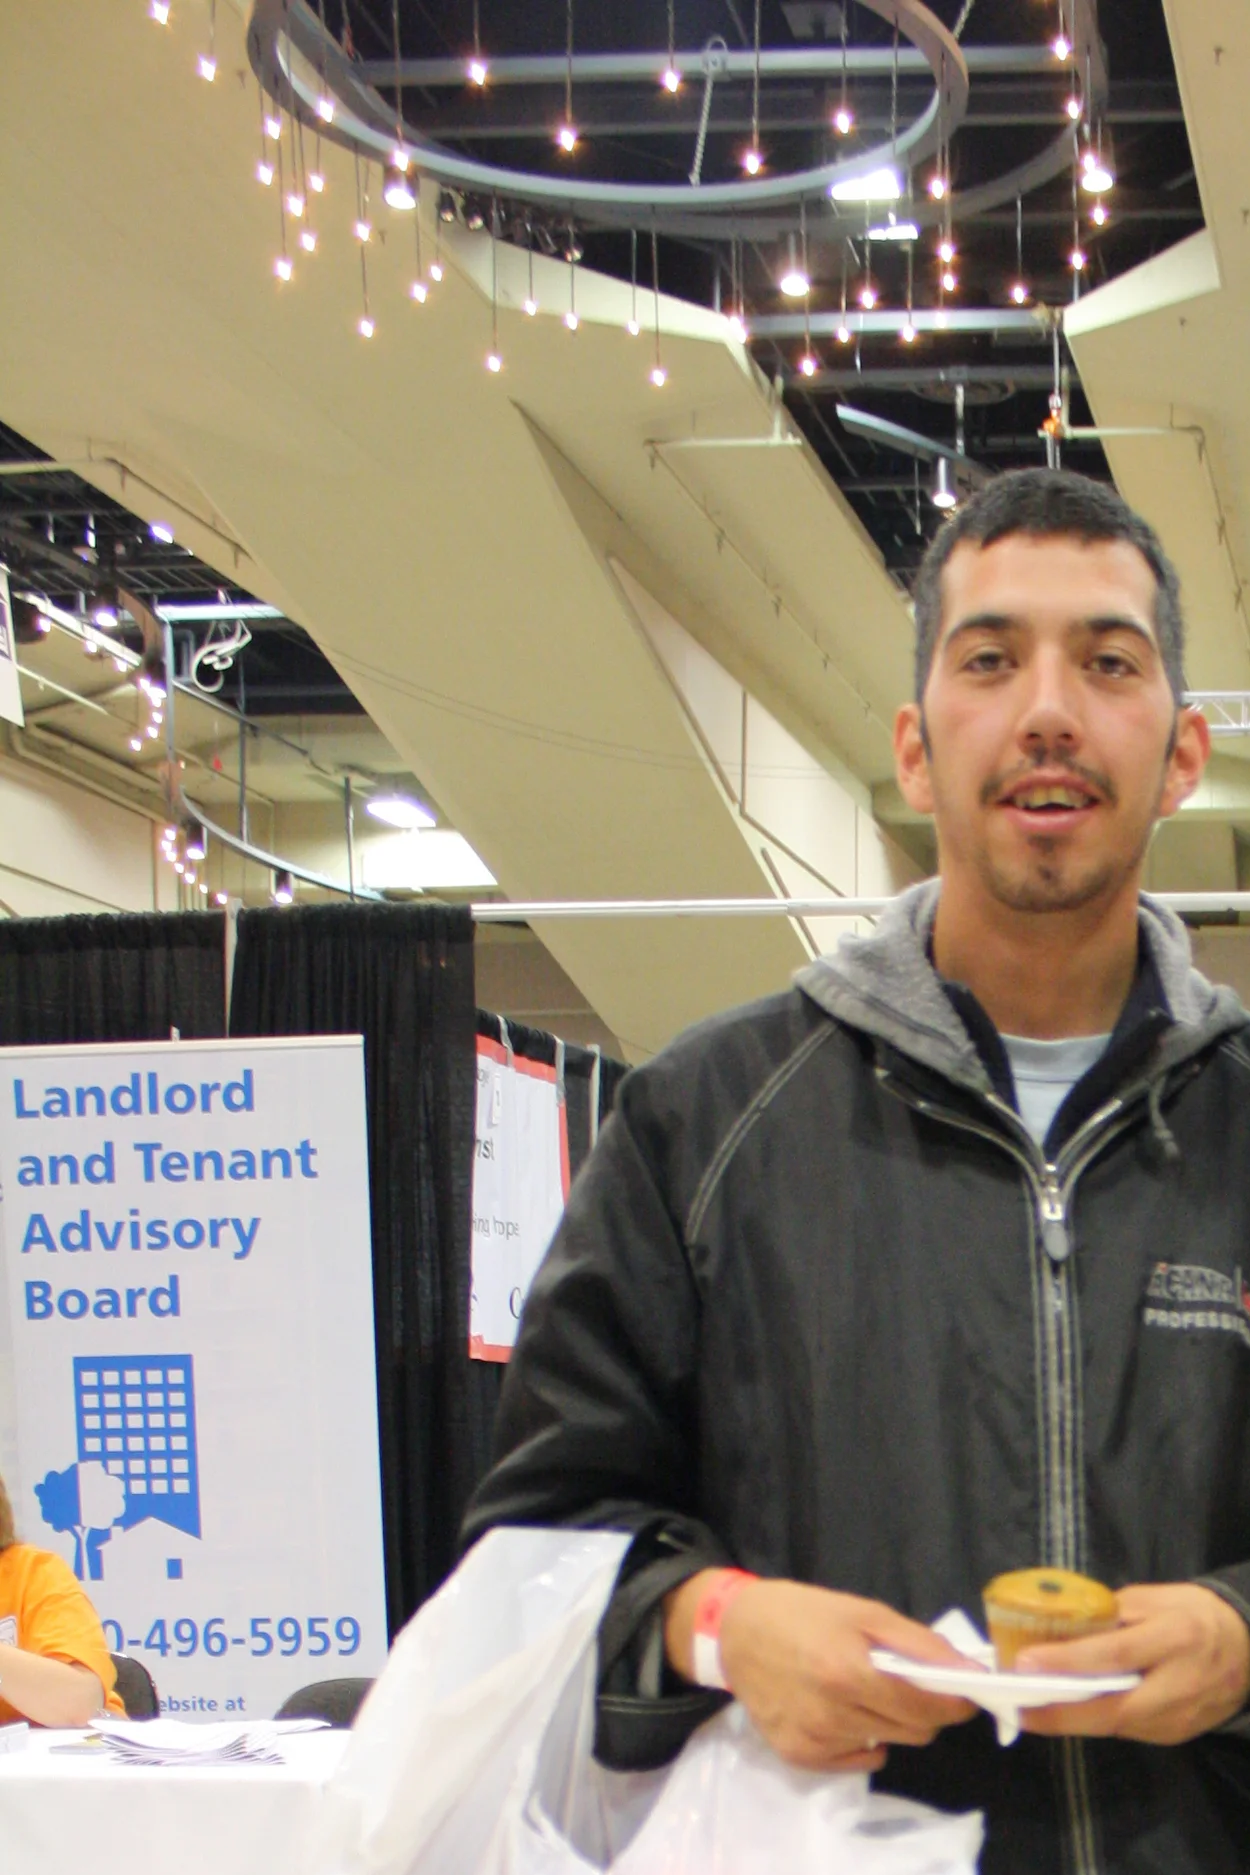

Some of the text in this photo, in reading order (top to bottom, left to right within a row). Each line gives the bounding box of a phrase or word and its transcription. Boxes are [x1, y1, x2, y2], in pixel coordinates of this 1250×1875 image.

[13, 1069, 255, 1119] Landlord
[17, 1139, 319, 1187] and Tenant
[21, 1208, 261, 1260] Advisory
[24, 1274, 181, 1320] Board
[225, 1697, 246, 1711] at
